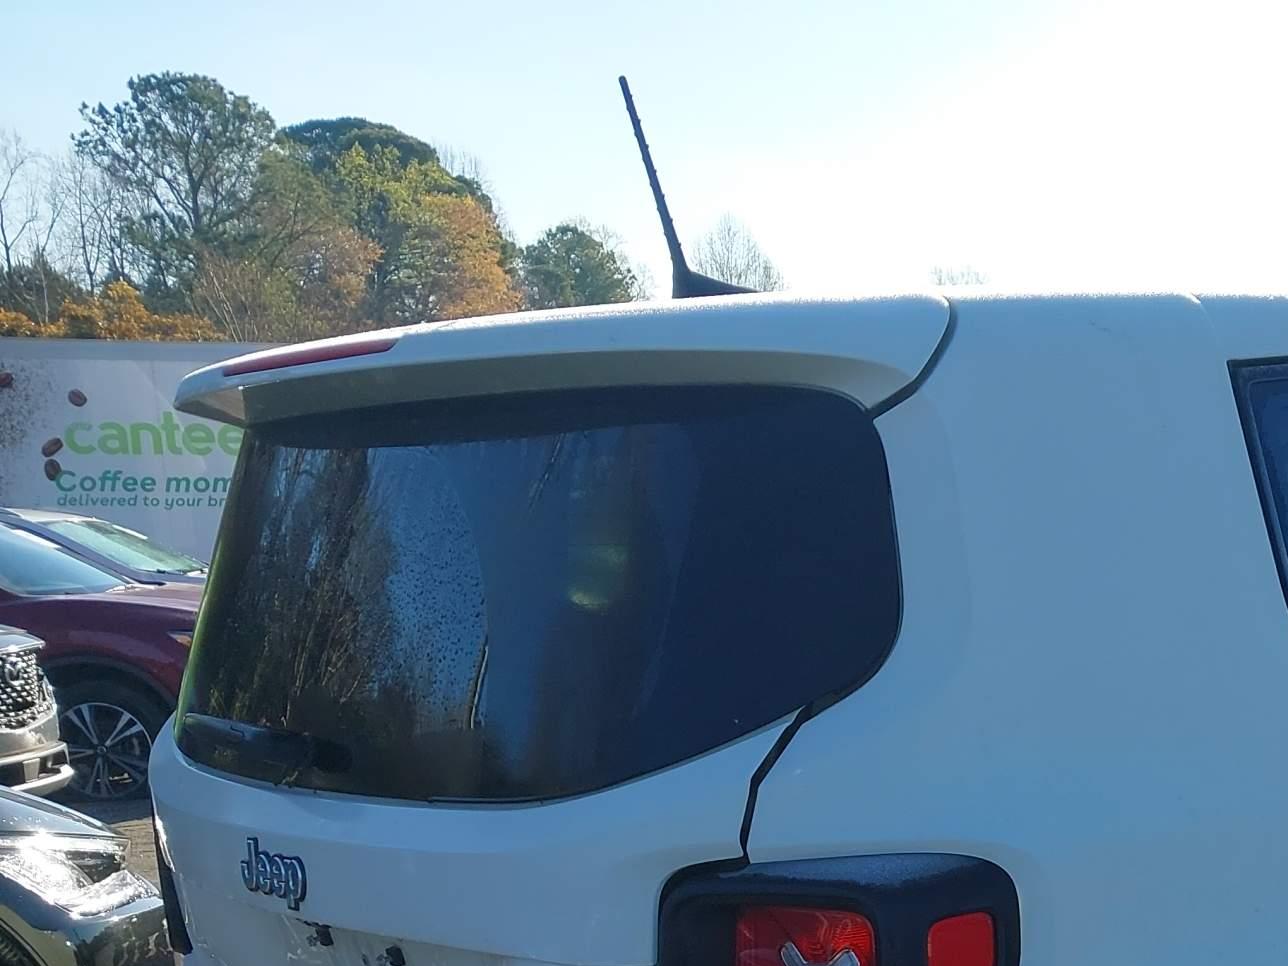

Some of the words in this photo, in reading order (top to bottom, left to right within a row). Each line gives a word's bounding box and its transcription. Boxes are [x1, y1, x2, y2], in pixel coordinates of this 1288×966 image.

[64, 411, 243, 456] cantee
[55, 470, 157, 493] Coffee
[57, 494, 137, 507] delivered
[143, 495, 160, 507] to
[165, 496, 203, 510] your
[240, 836, 307, 911] Jeep
